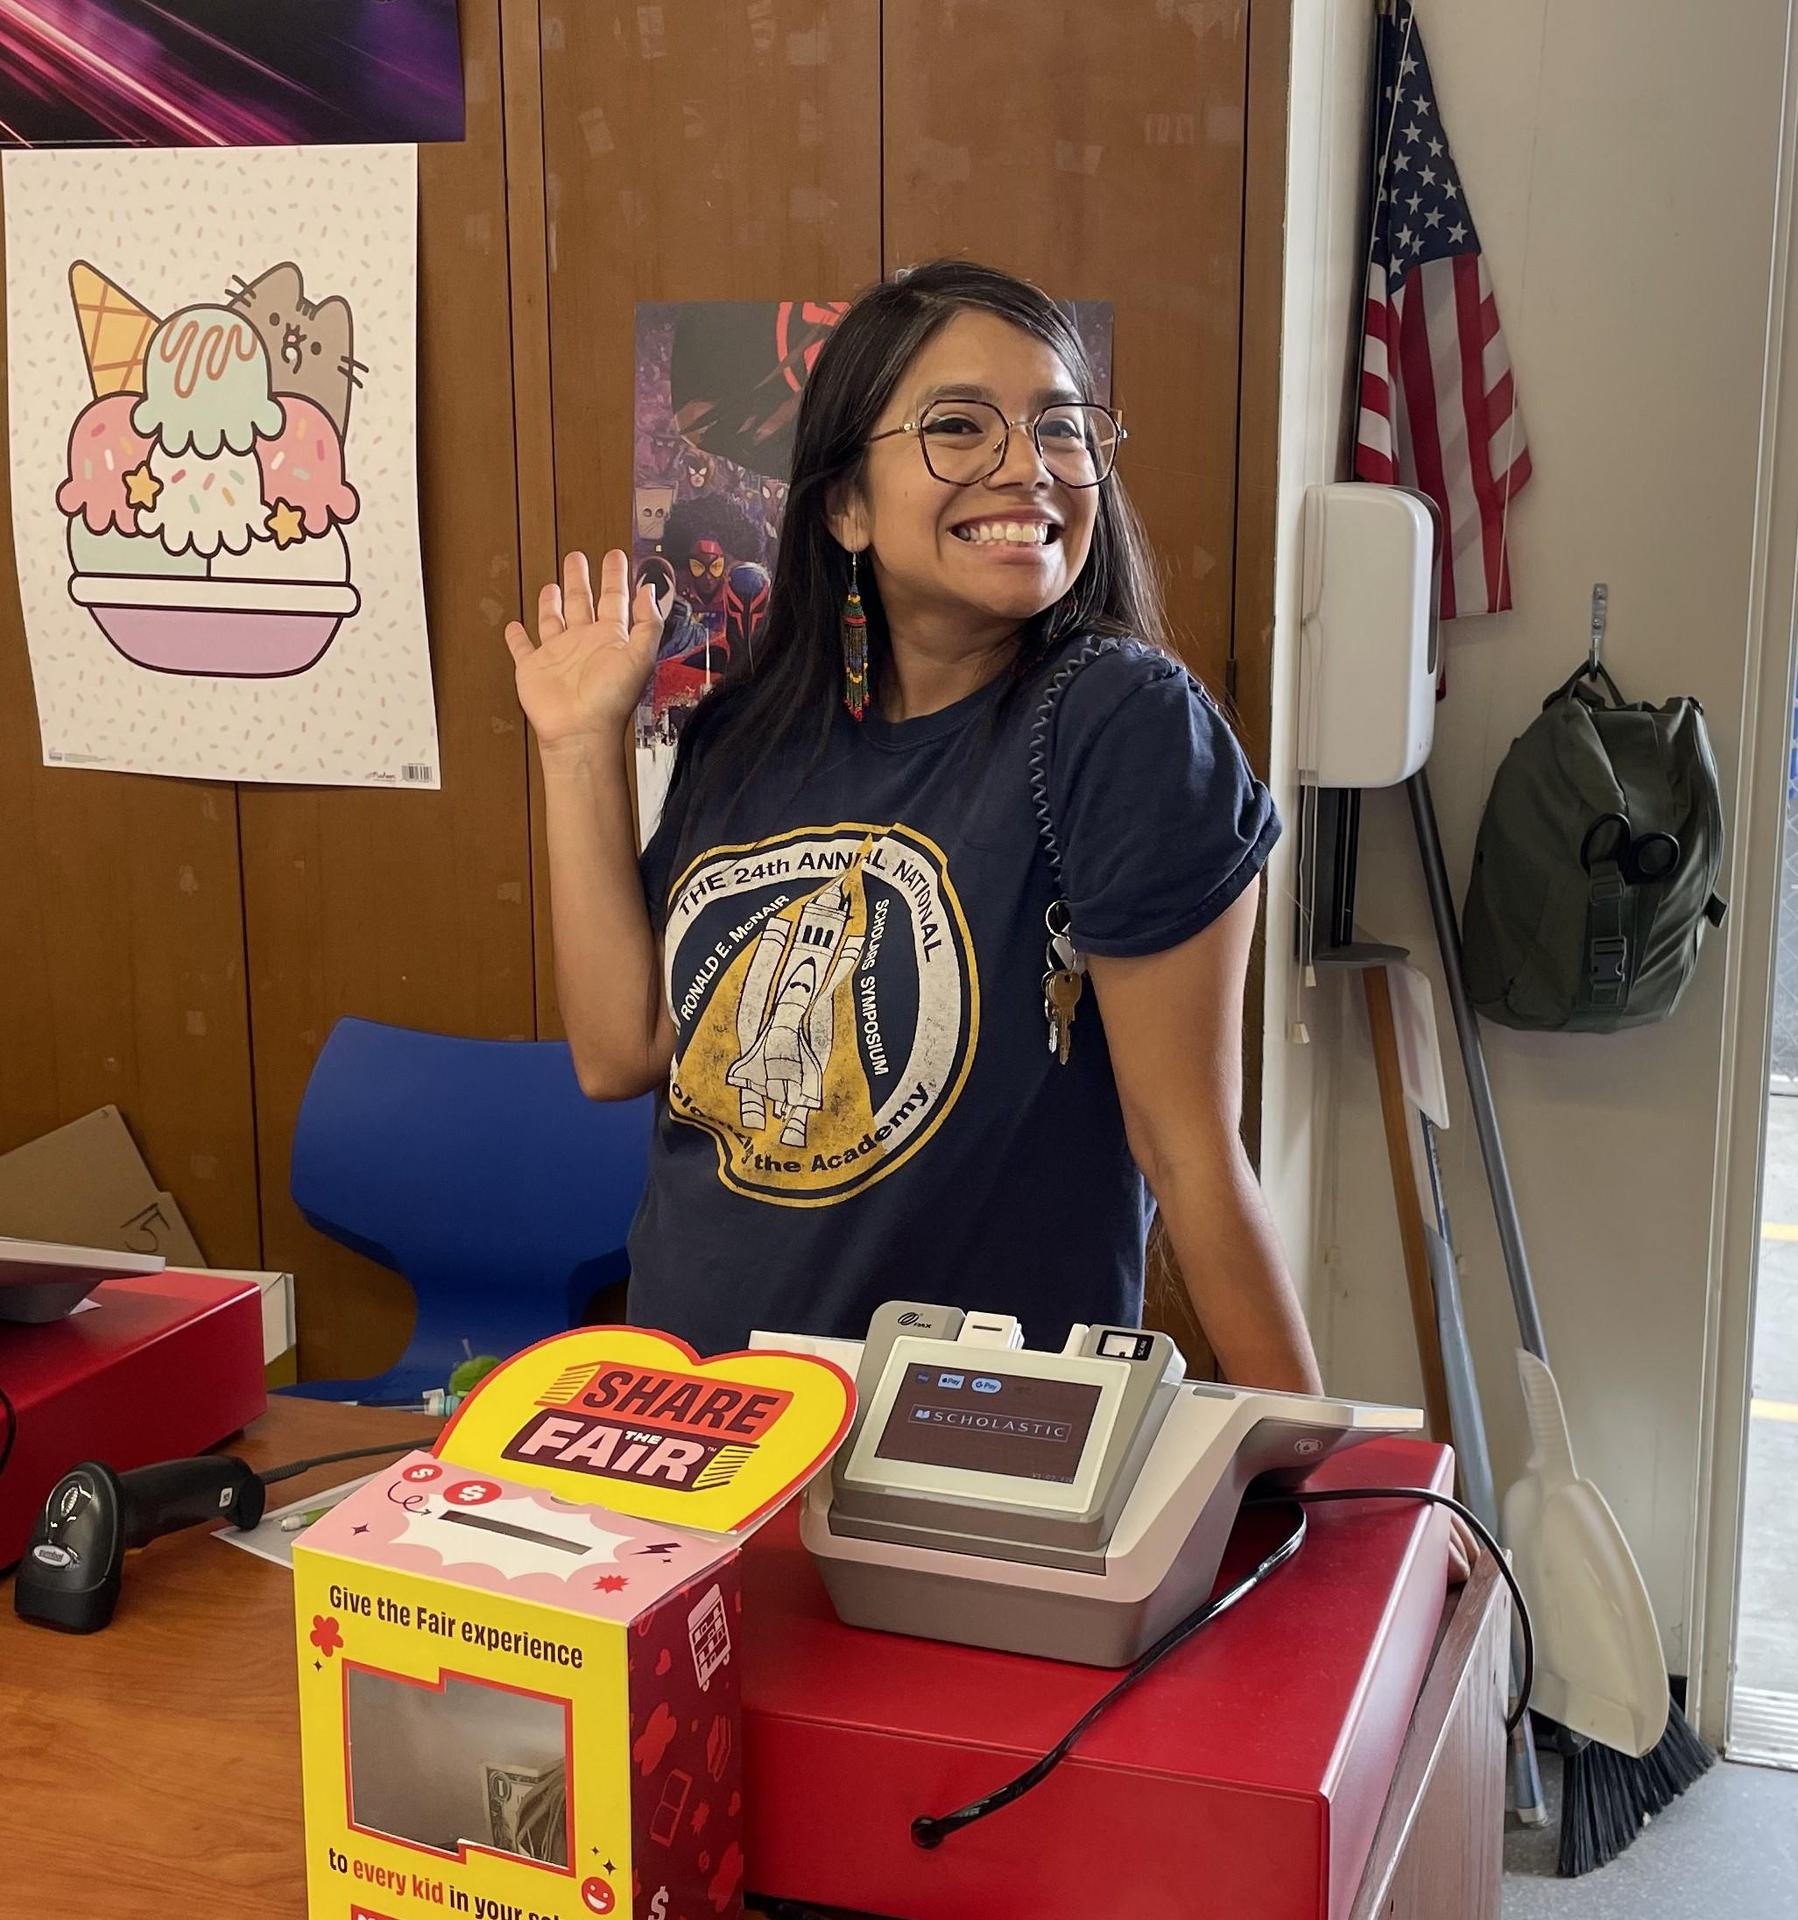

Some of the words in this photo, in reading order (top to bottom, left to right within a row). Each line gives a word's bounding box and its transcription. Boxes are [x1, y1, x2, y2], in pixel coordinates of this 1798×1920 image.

[678, 871, 726, 916] THE
[734, 859, 790, 885] 24th
[892, 859, 943, 963] NATIONAL
[680, 955, 719, 1021] RONALD
[715, 941, 733, 959] E.
[728, 895, 790, 943] McNAIR
[860, 975, 890, 1077] SYMPOSIUM
[754, 1154, 801, 1173] the
[811, 1081, 930, 1172] Academy
[582, 1370, 780, 1434] SHARE
[624, 1430, 665, 1445] THE
[933, 1411, 1064, 1437] SCHOLASTIC
[518, 1416, 705, 1482] FAIR
[329, 1584, 371, 1616] Give
[377, 1596, 410, 1626] the
[417, 1606, 456, 1638] Fair
[461, 1620, 583, 1669] experience
[328, 1847, 348, 1874] to
[353, 1858, 407, 1896] every
[412, 1874, 444, 1905] kid
[449, 1885, 469, 1912] in
[474, 1896, 522, 1920] your
